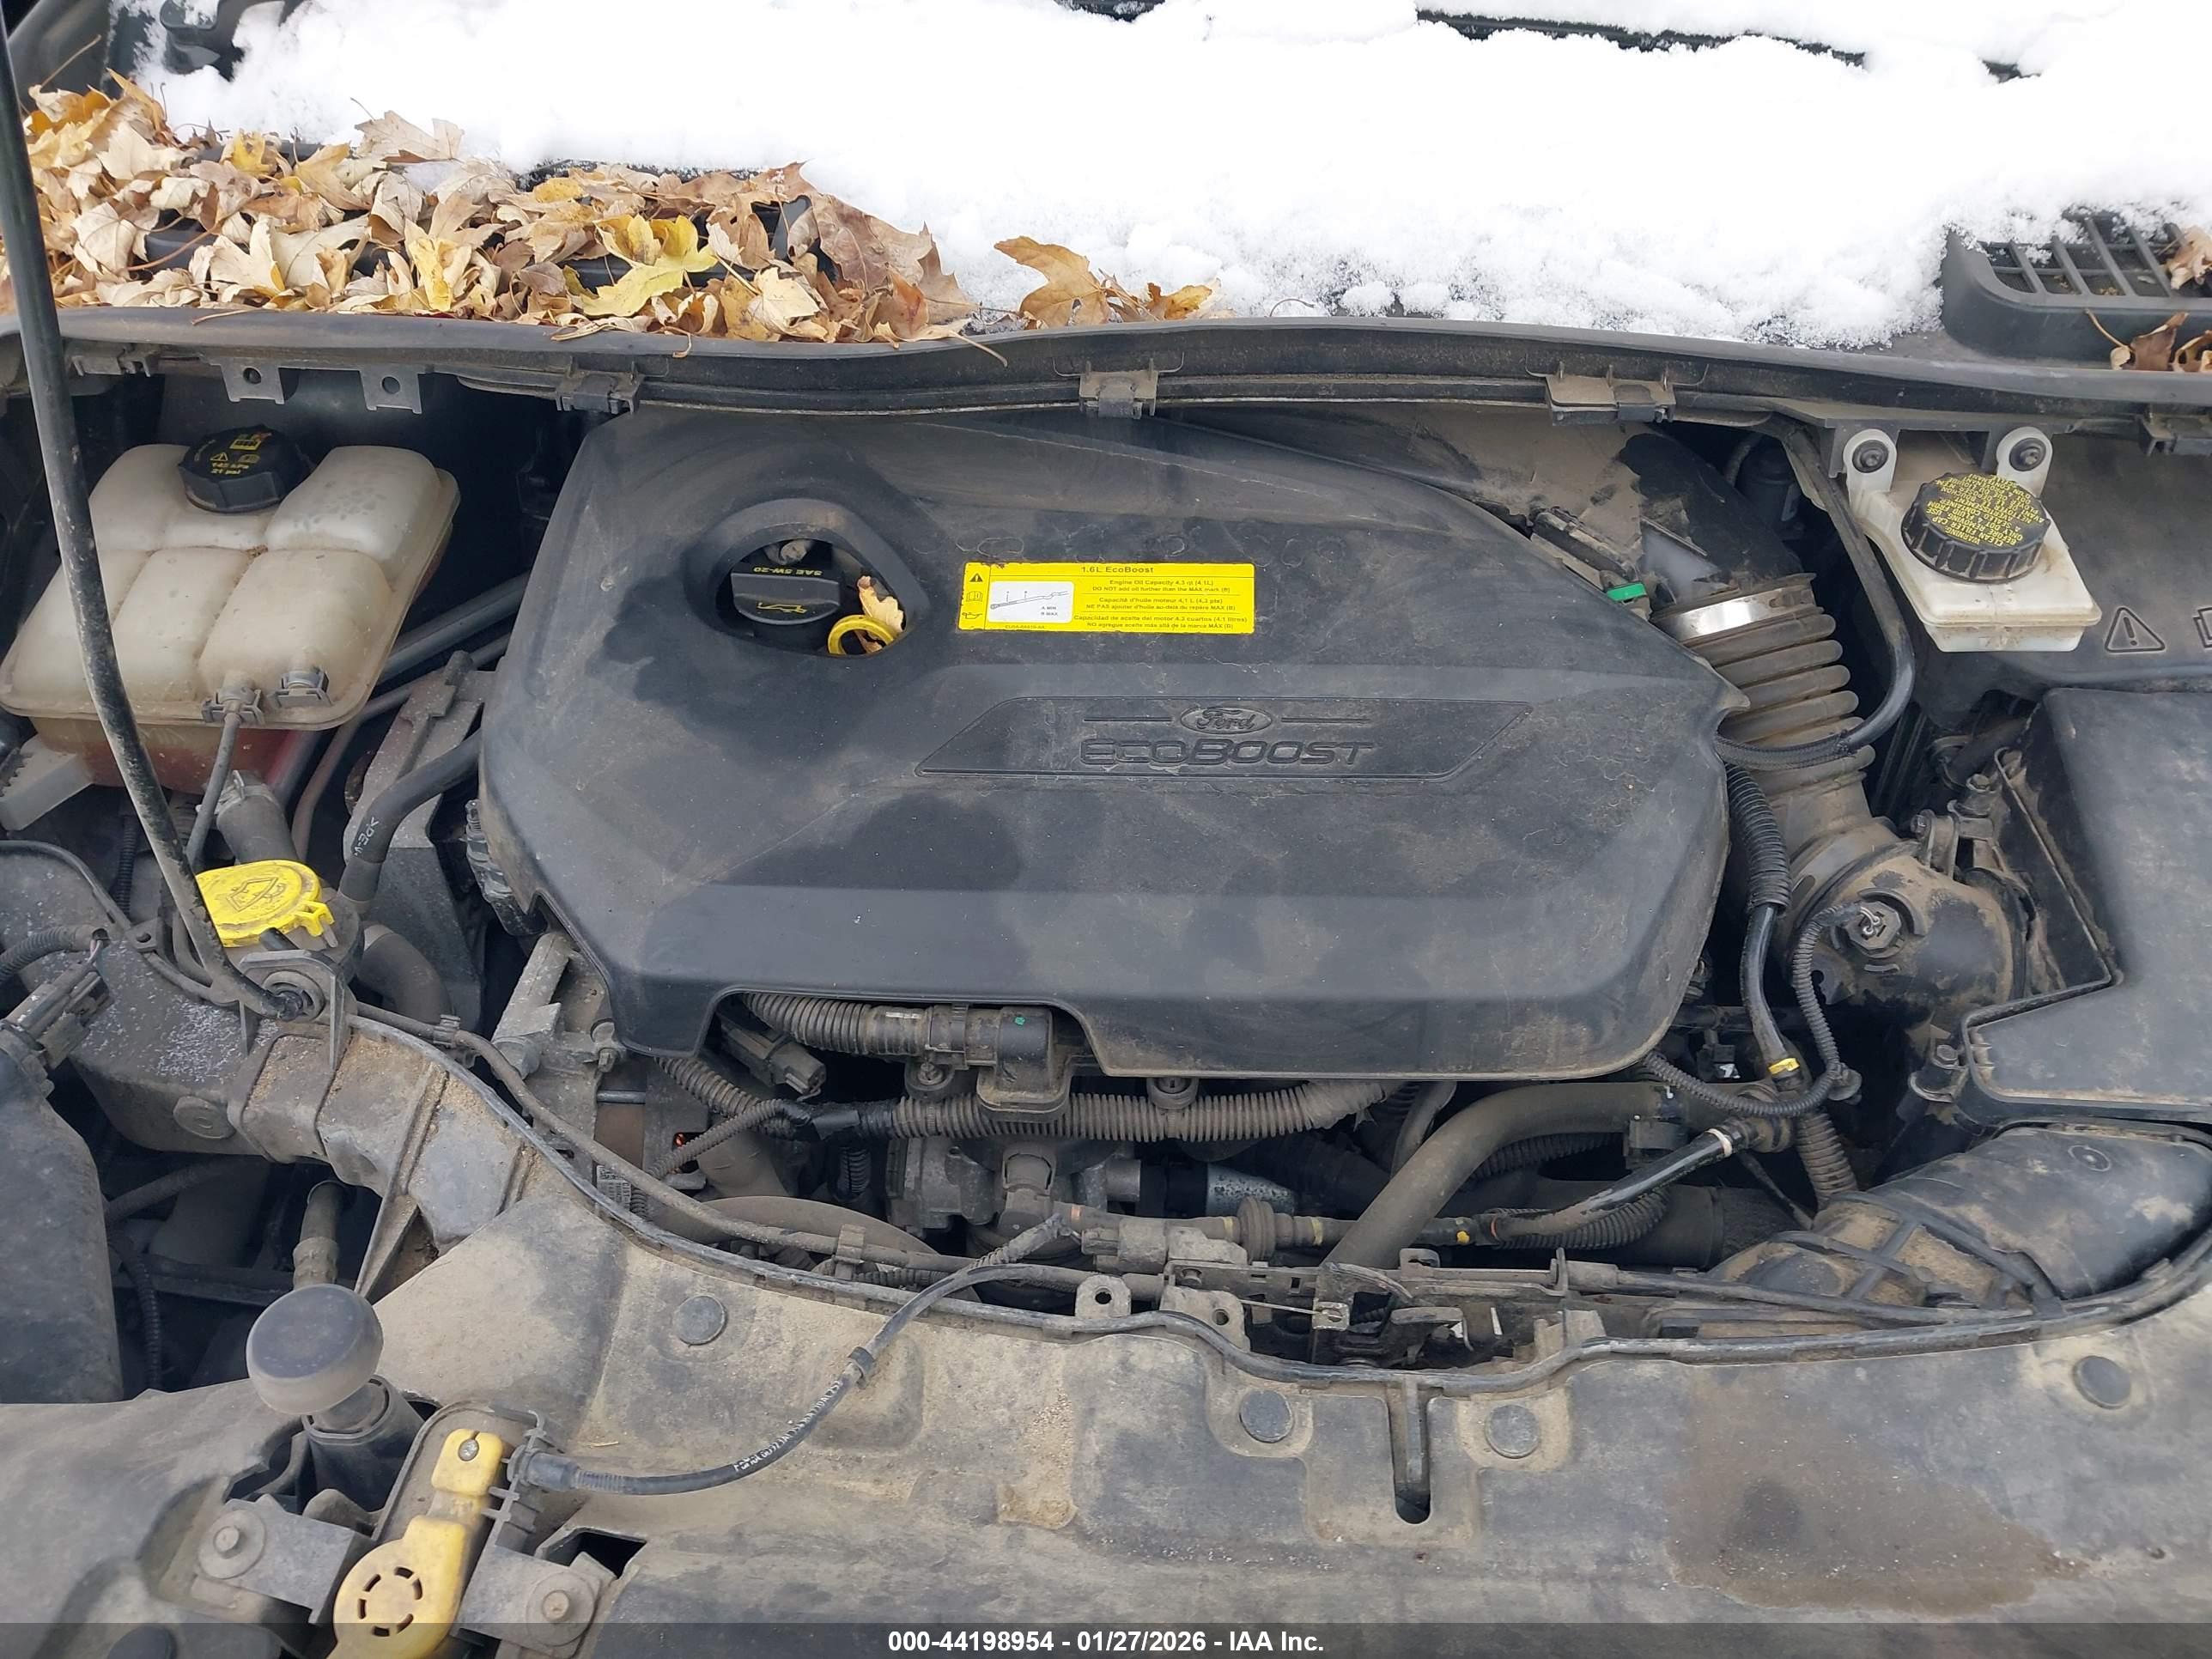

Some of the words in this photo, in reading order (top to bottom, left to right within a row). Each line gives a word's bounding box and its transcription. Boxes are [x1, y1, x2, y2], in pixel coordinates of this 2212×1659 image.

[1926, 507, 1942, 516] USE
[1927, 501, 1949, 512] FROM
[1931, 516, 1948, 526] CAP
[1953, 509, 1974, 520] FLUID
[1995, 505, 2032, 524] NETTOYER
[2018, 511, 2044, 523] AVANT
[1951, 520, 1976, 535] FILLER
[1983, 514, 2011, 529] SEALED
[1985, 521, 2000, 531] DOT
[1978, 532, 2002, 546] CLEAN
[1986, 528, 2017, 544] BEFORE
[2002, 527, 2023, 540] ONLY
[1196, 708, 1256, 731] Ford
